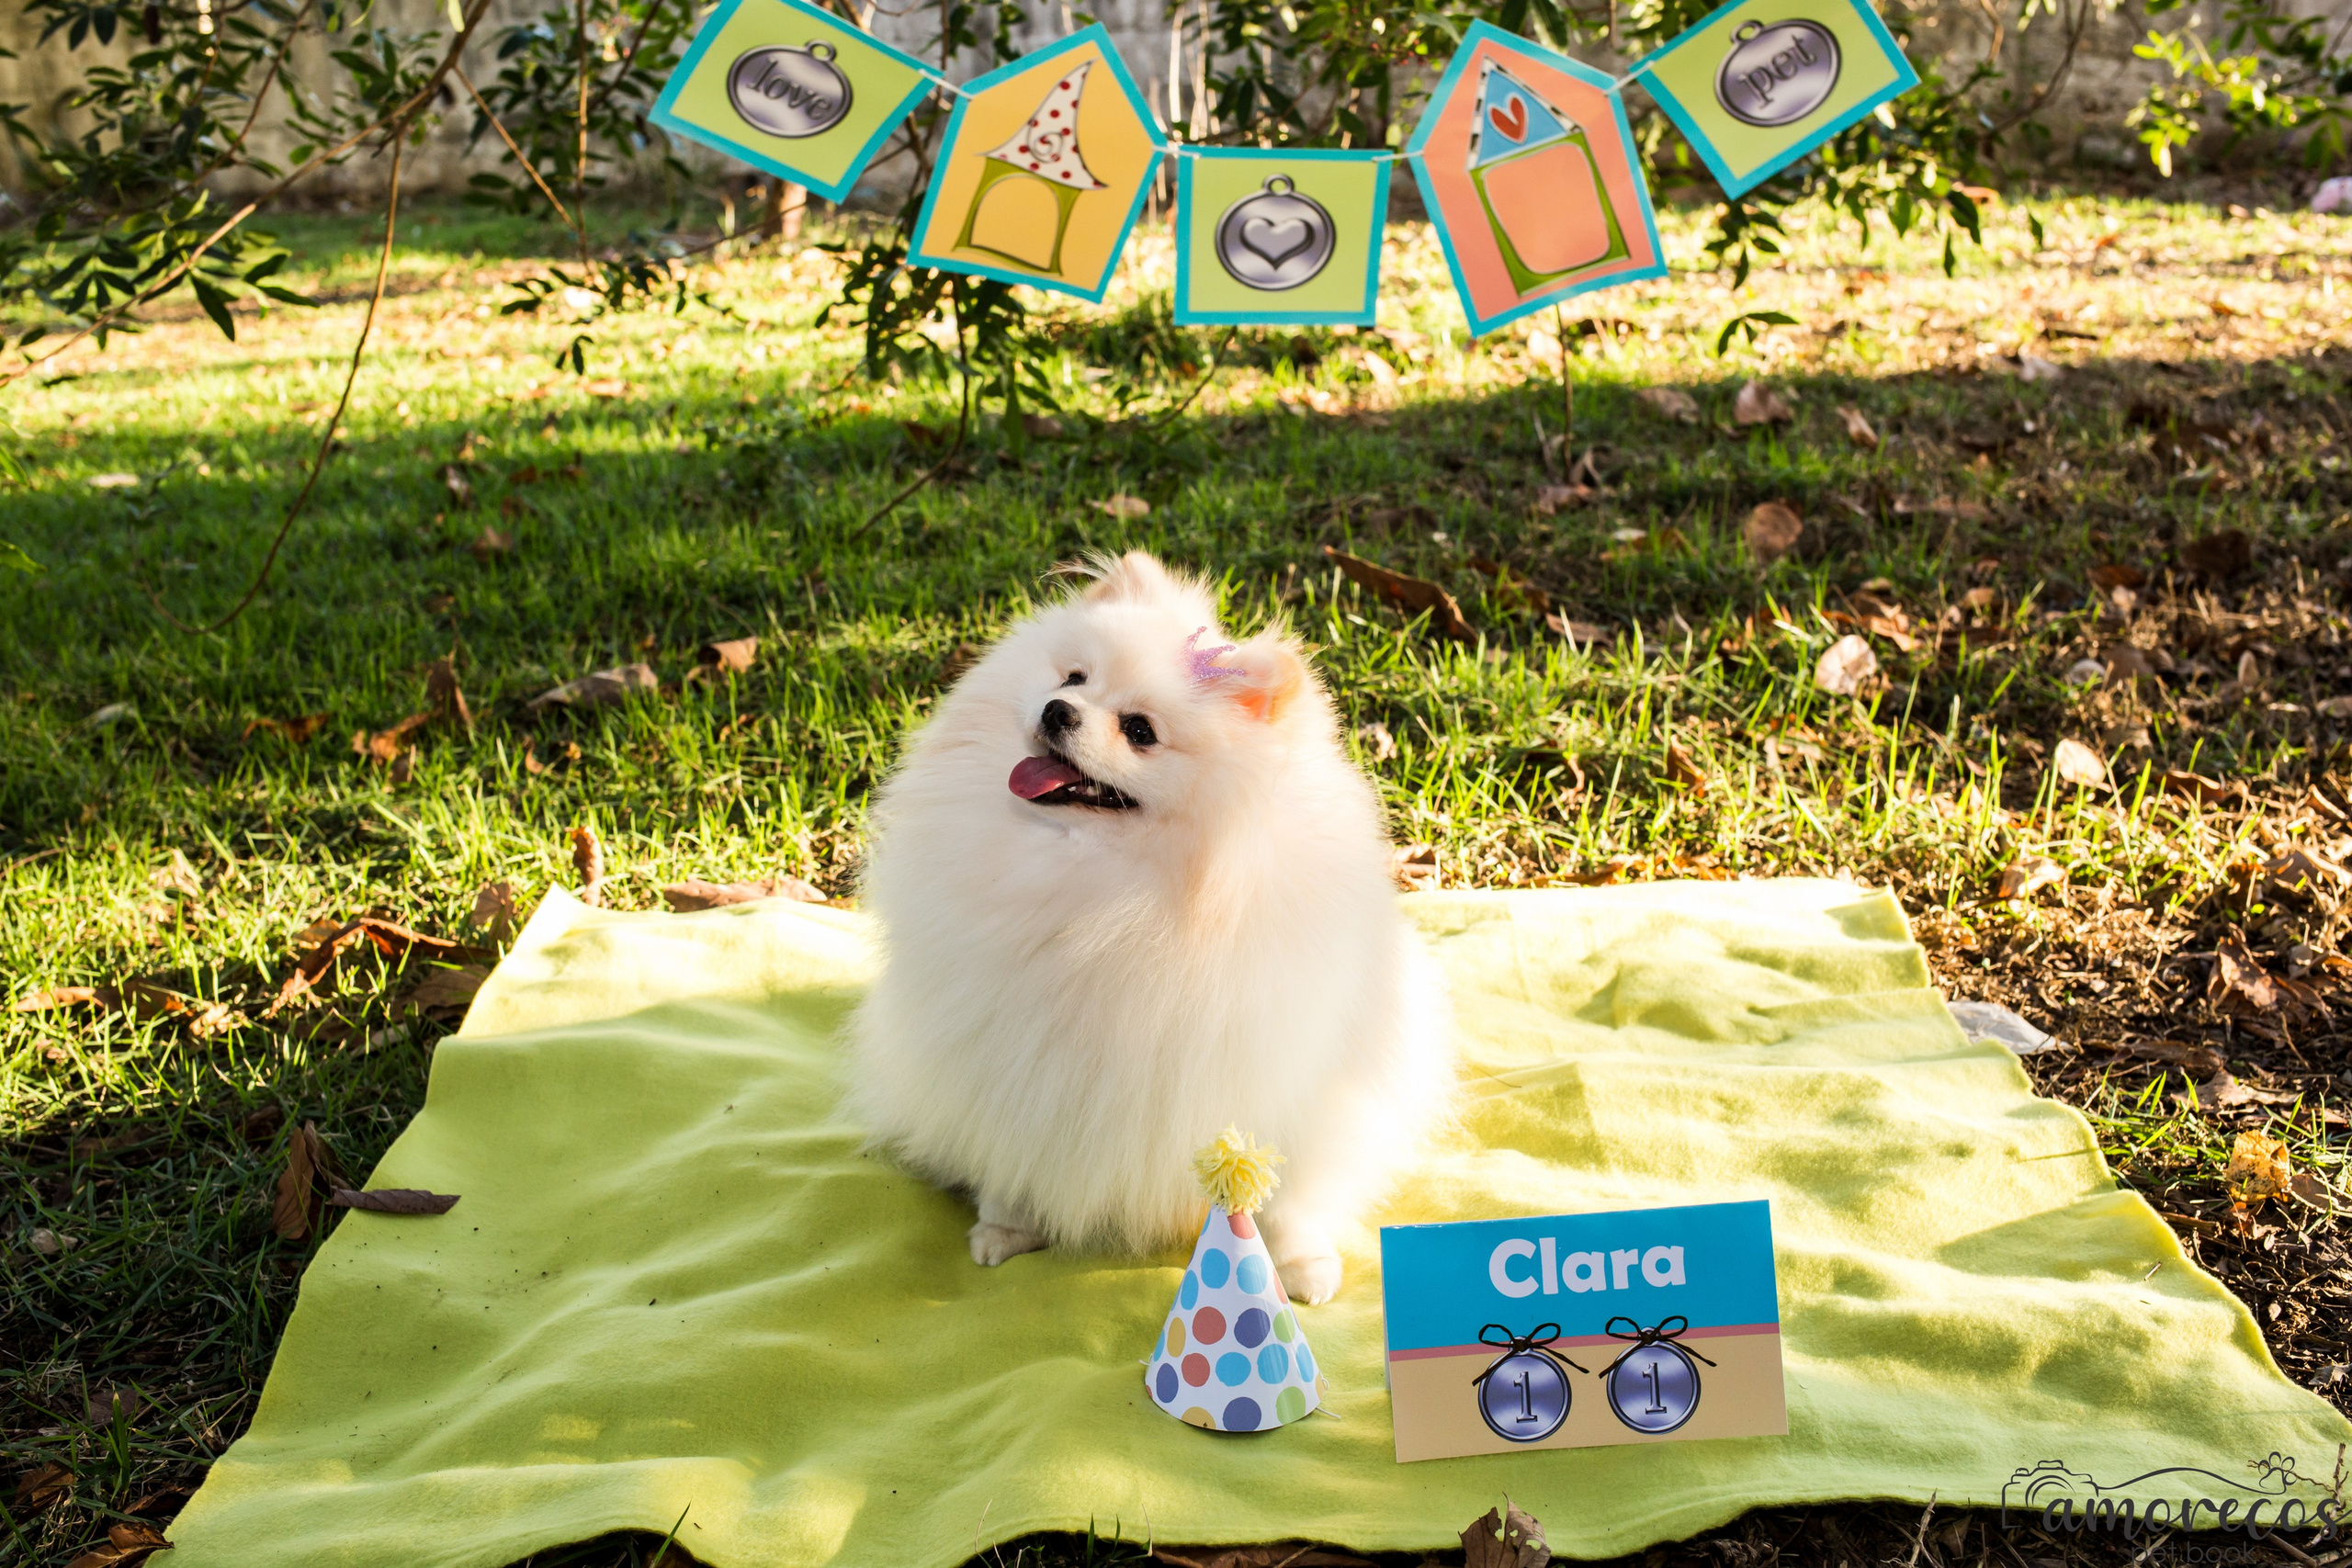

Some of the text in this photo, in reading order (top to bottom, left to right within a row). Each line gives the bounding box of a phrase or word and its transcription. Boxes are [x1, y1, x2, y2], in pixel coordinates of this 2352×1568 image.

[746, 57, 832, 120] love
[1737, 34, 1818, 109] pet
[1488, 1237, 1686, 1298] Clara
[1513, 1362, 1668, 1424] 1 1
